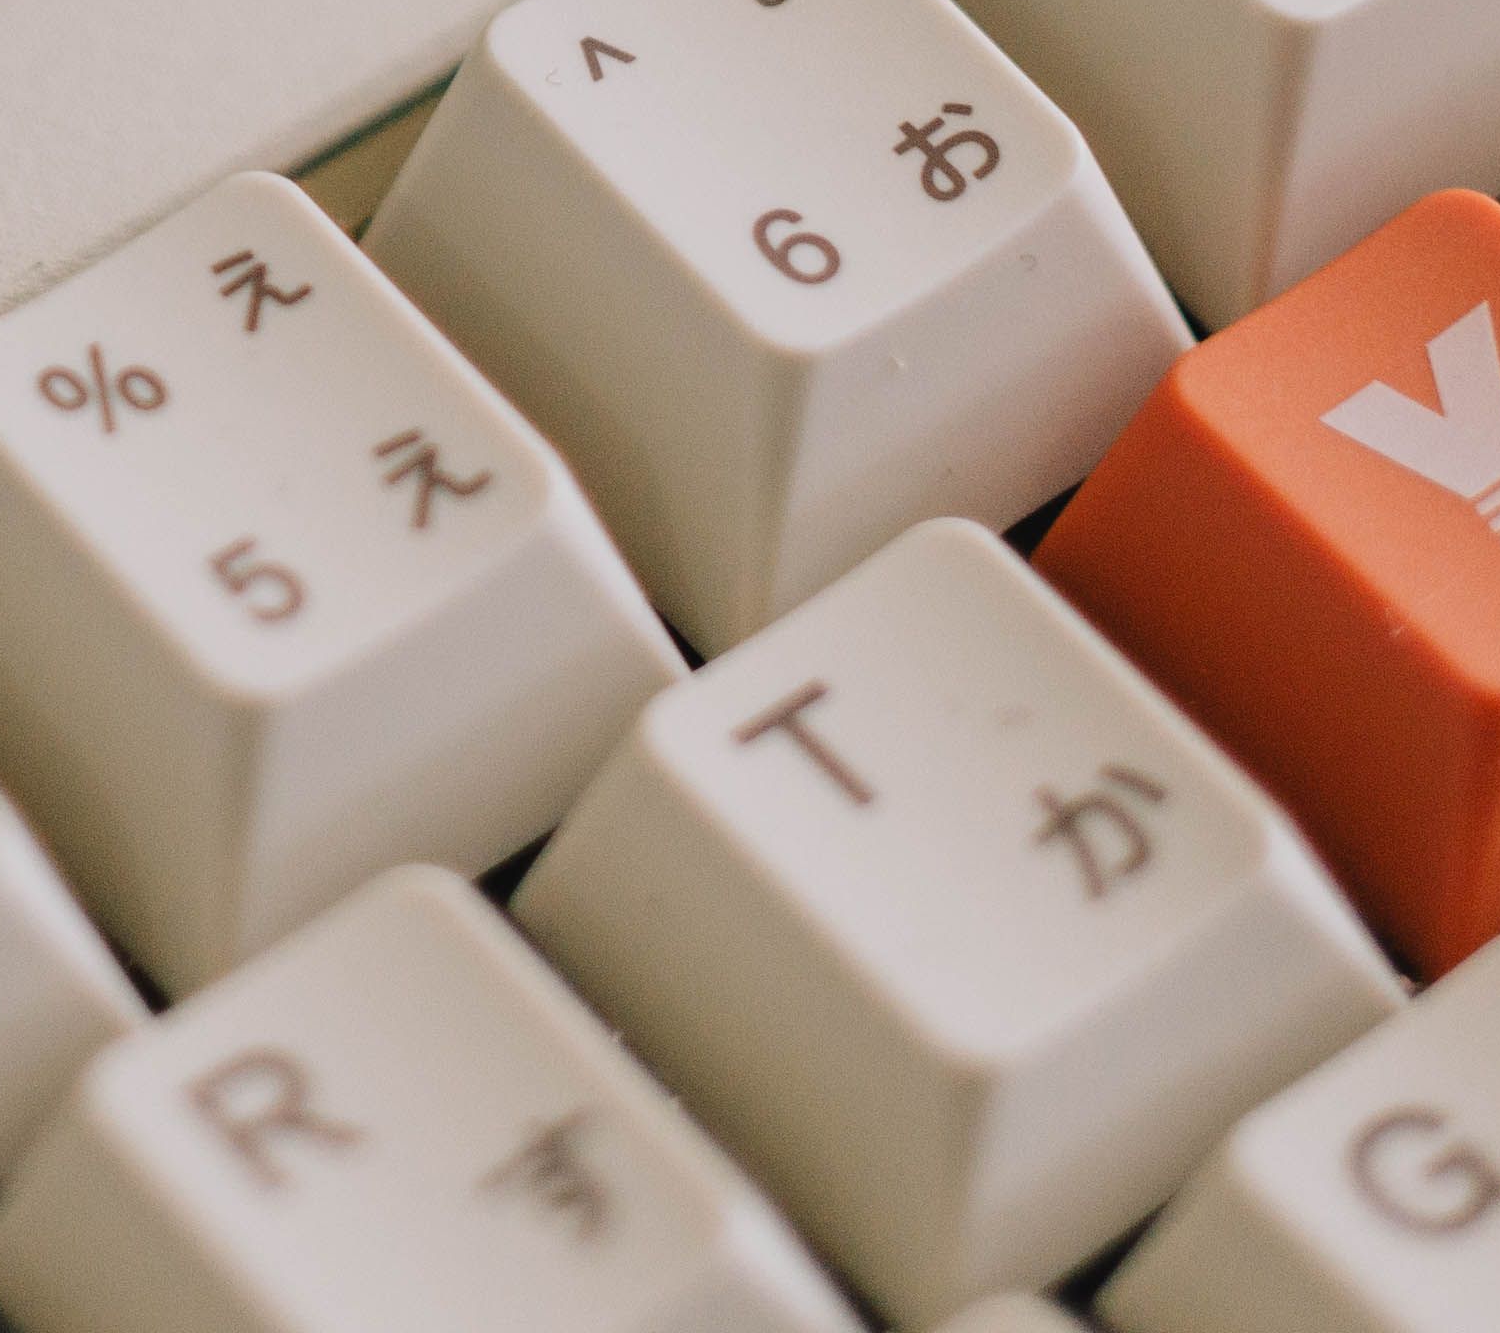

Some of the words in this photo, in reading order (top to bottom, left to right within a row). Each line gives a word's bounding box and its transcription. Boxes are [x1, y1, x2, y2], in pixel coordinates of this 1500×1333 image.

[751, 206, 841, 286] 6
[209, 536, 307, 625] 5
[732, 679, 875, 811] T
[184, 1047, 364, 1193] R
